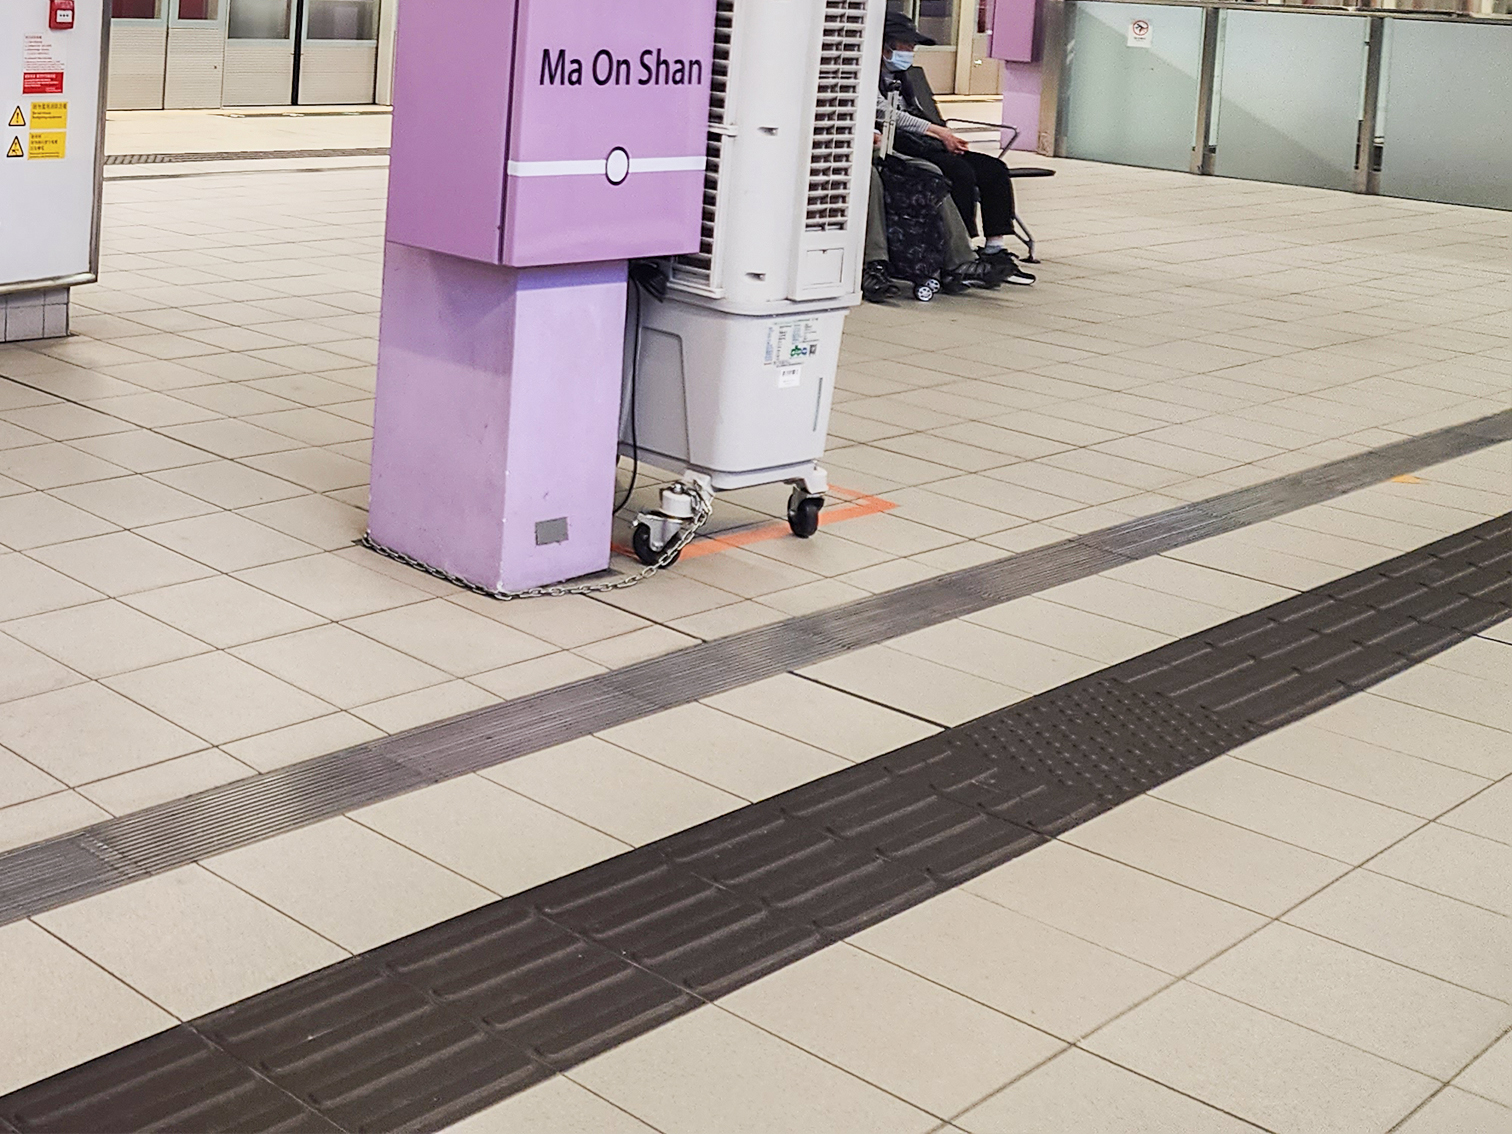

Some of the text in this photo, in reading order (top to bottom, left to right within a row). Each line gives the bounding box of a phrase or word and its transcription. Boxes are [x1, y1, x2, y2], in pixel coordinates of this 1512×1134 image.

[539, 48, 702, 86] Ma On Shan
